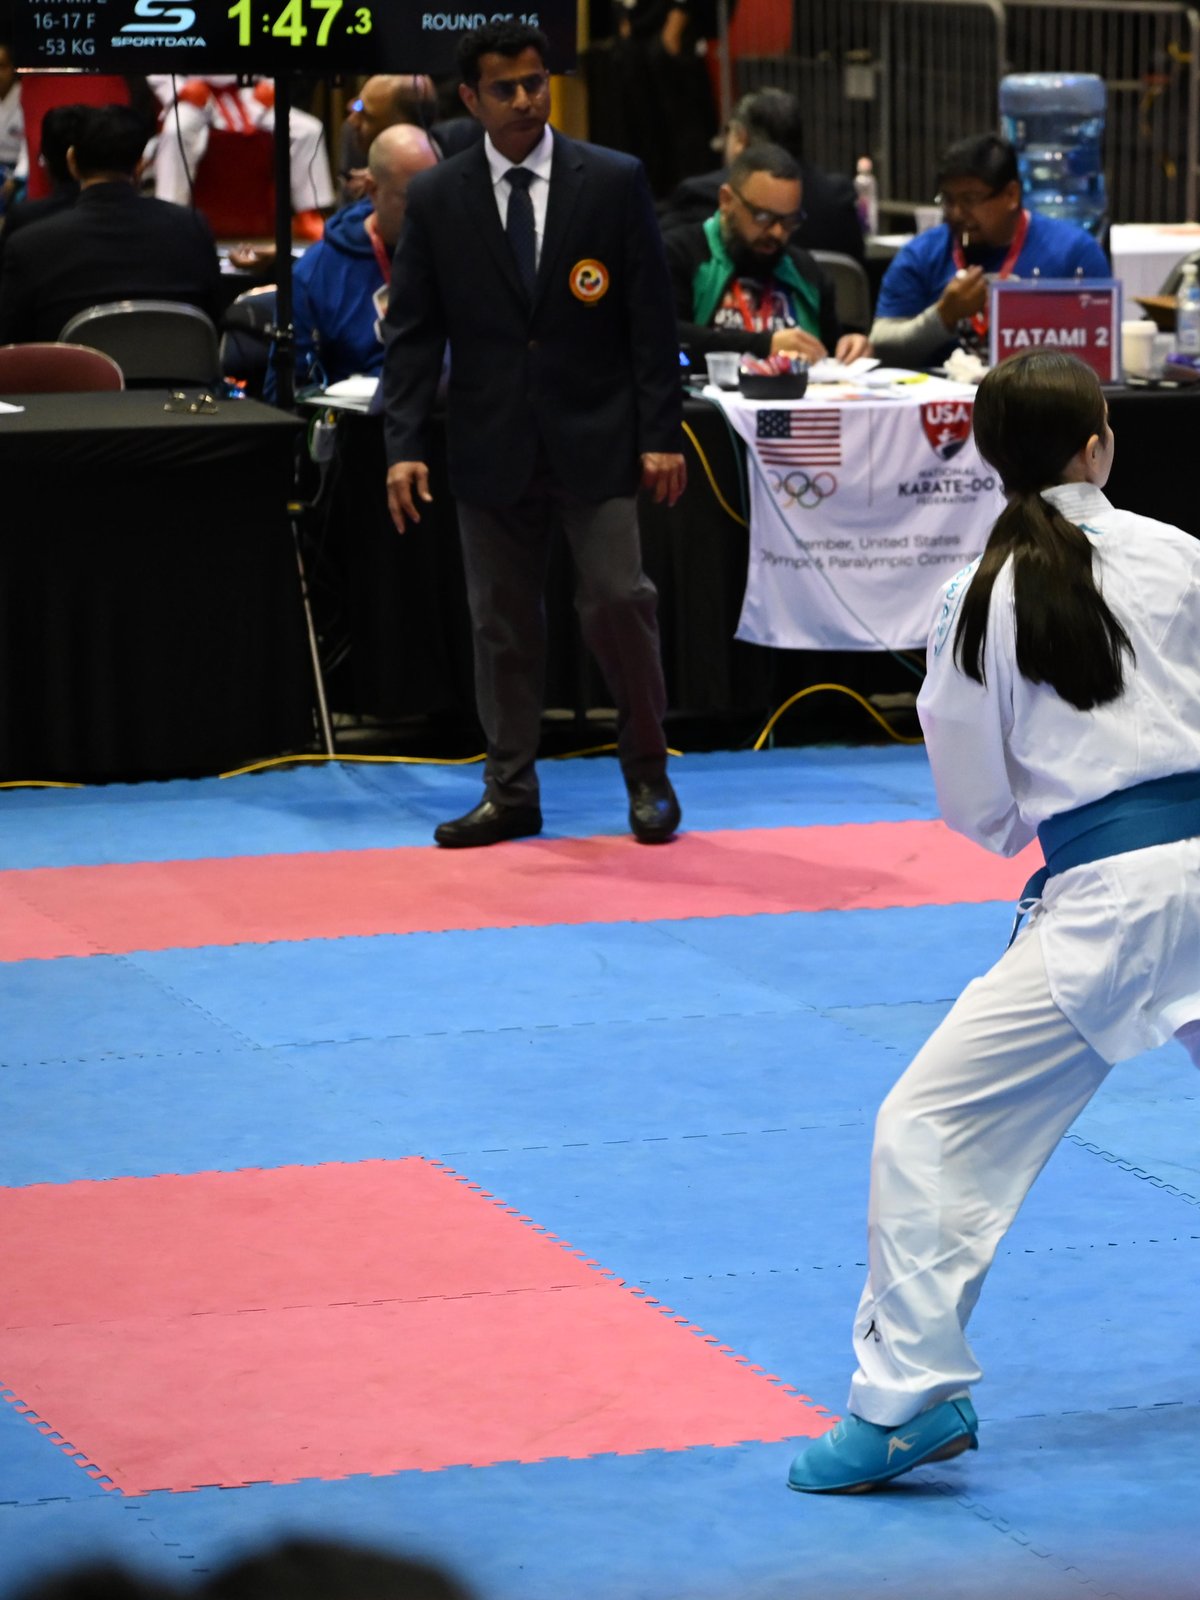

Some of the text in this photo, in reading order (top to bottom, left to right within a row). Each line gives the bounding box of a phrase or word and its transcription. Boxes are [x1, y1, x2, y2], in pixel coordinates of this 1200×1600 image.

[33, 13, 96, 29] 16-17 F
[421, 13, 487, 30] ROUND
[38, 39, 96, 56] -53 KG
[111, 36, 206, 47] SPORTDATA
[1001, 326, 1109, 347] TATAMI 2
[926, 403, 969, 425] USA
[898, 477, 995, 497] KARATE-DO
[859, 536, 908, 549] United
[913, 534, 960, 548] States
[828, 553, 912, 570] Paralympic
